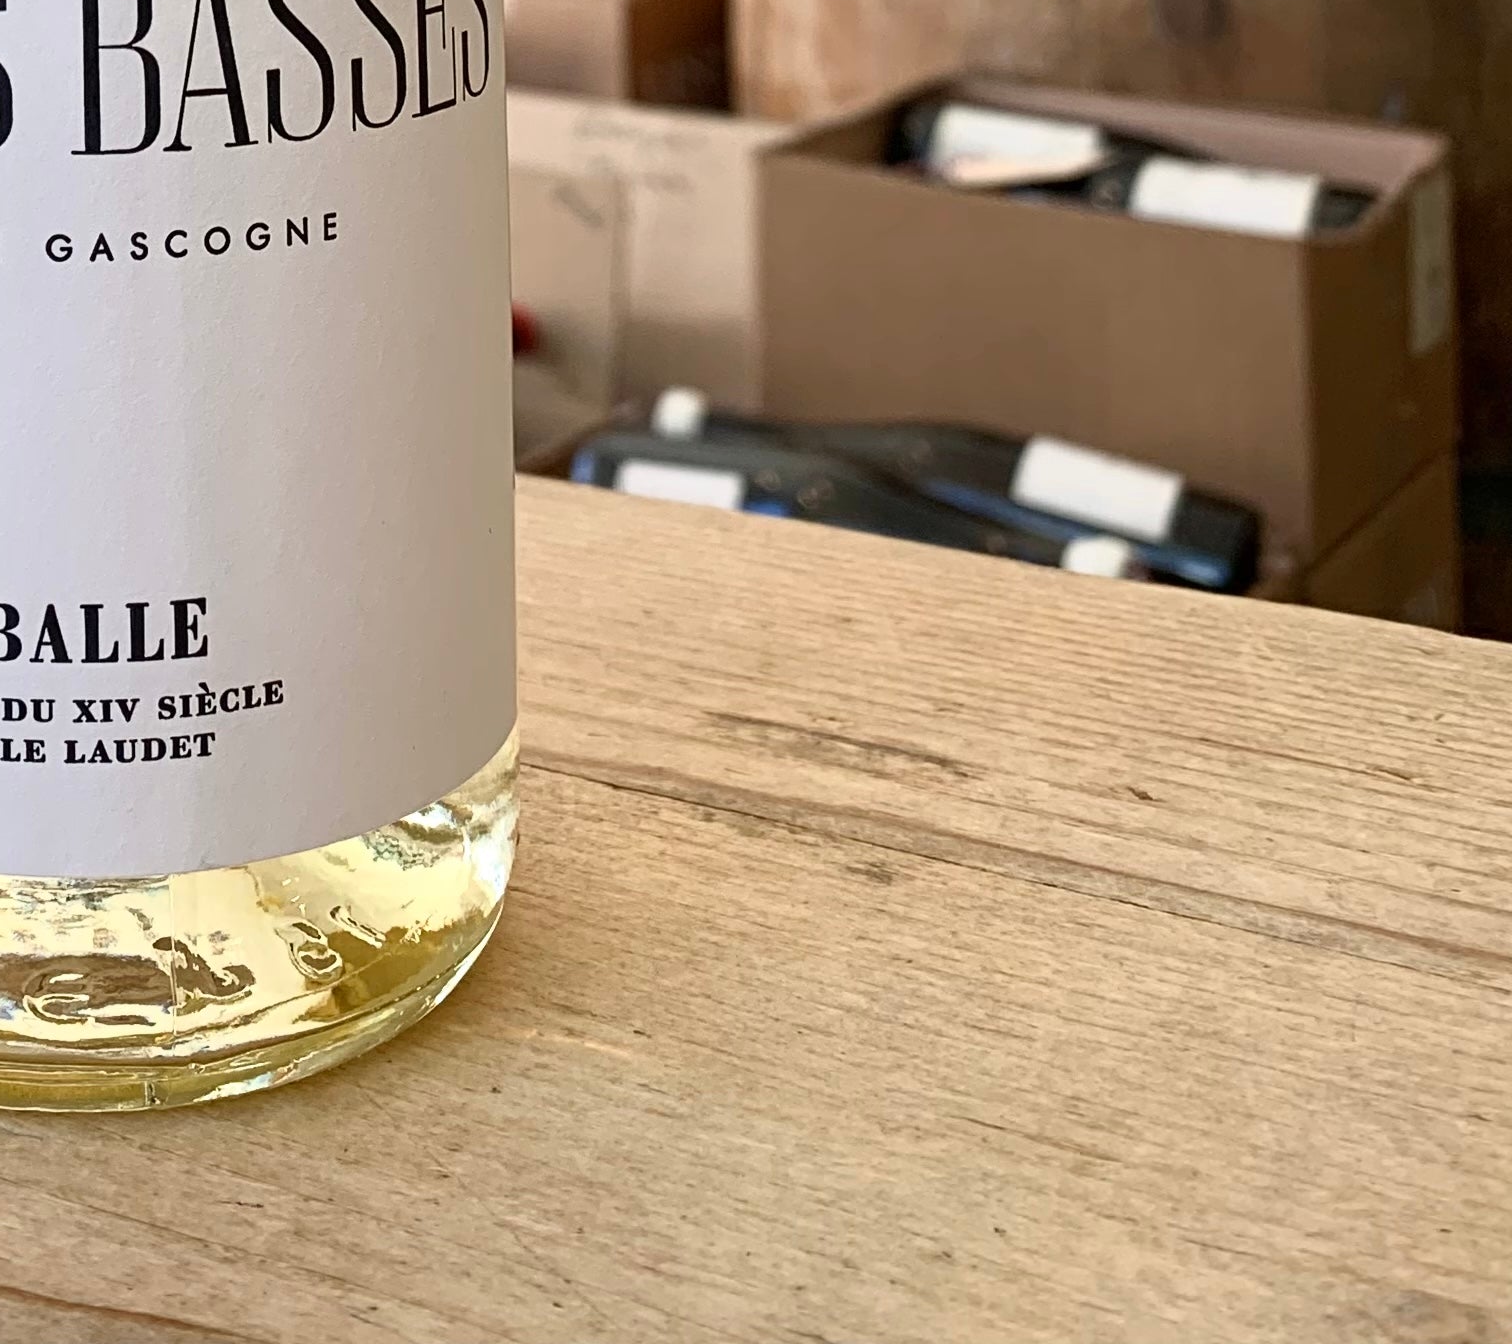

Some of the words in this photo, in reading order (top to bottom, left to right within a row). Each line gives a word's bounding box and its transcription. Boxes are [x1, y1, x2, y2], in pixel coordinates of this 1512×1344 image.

[44, 211, 338, 263] GASCOGNE
[0, 697, 57, 724] DU
[71, 697, 141, 725] XIV
[157, 679, 285, 721] SIÈCLE
[62, 731, 216, 765] LAUDET
